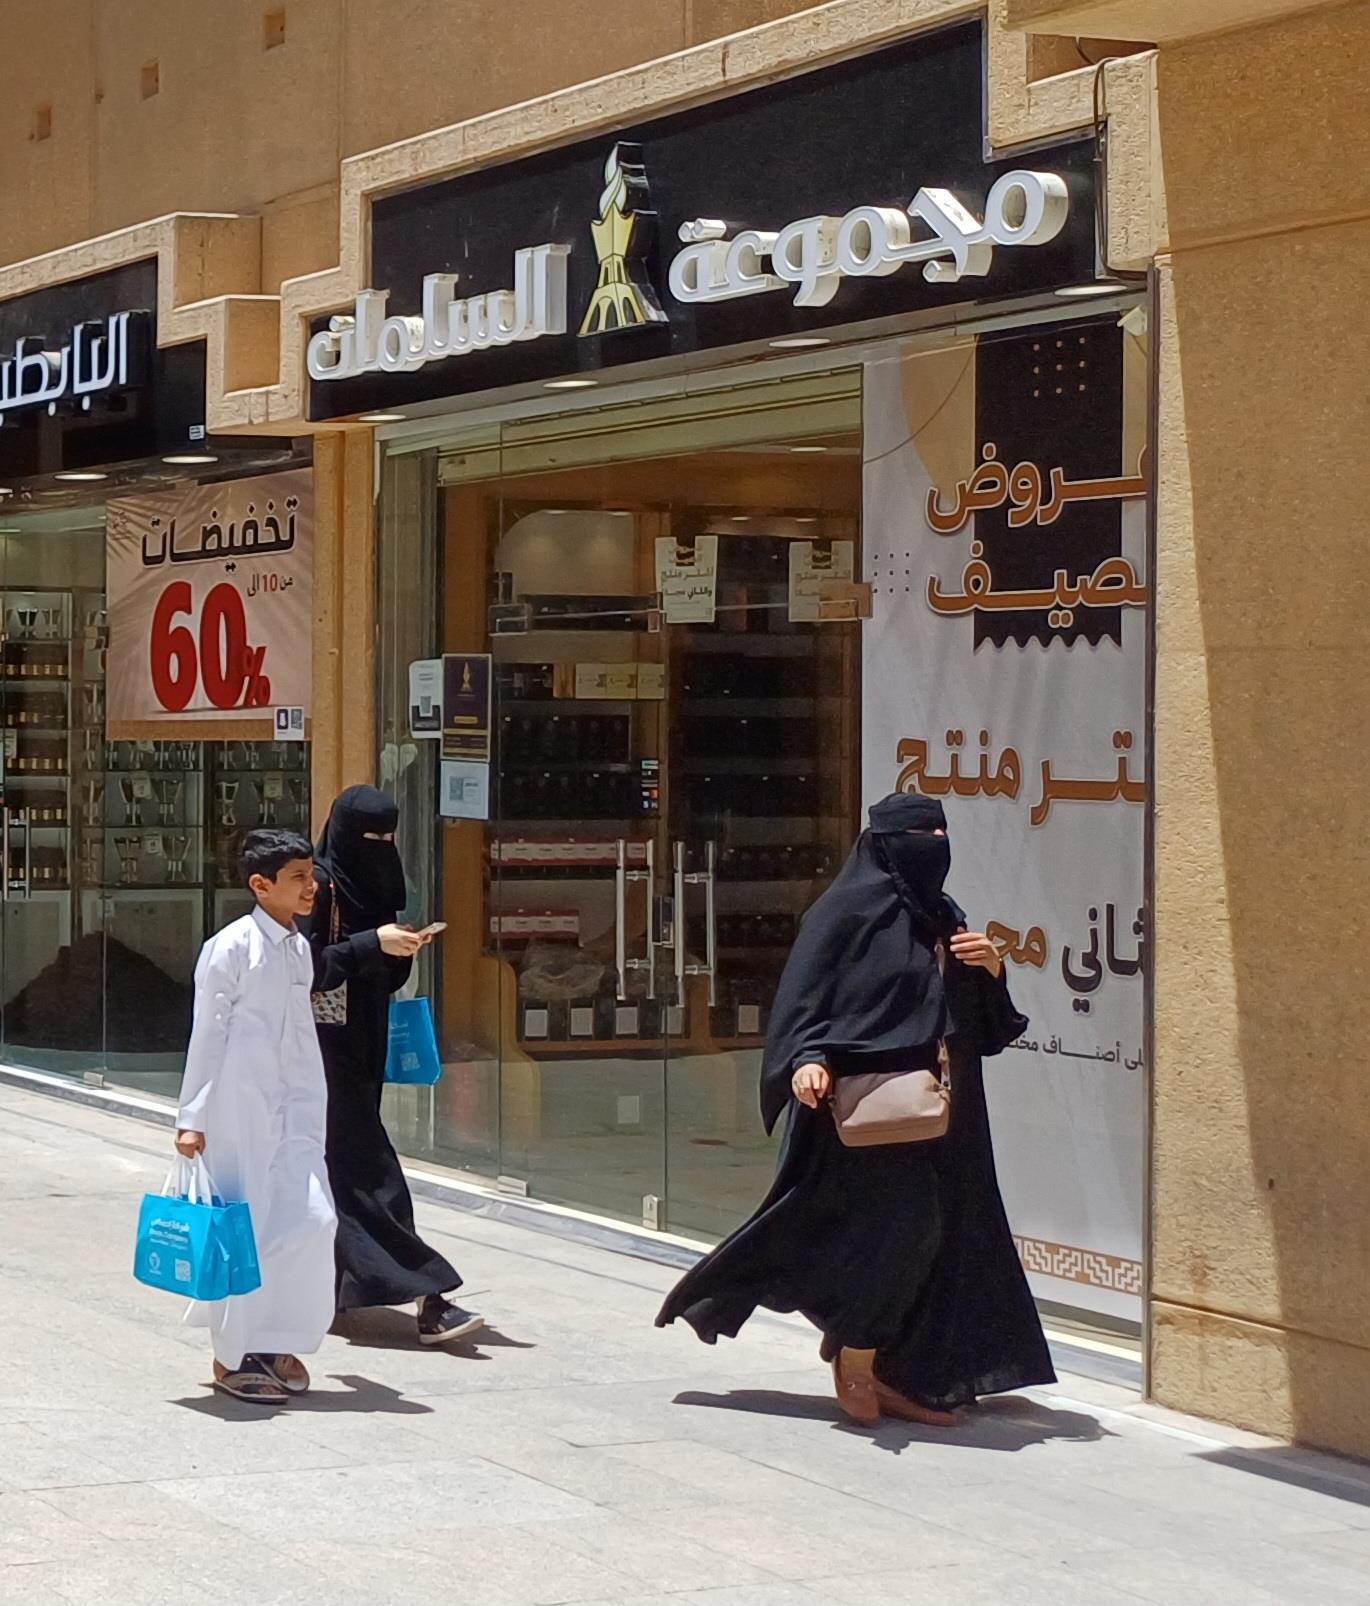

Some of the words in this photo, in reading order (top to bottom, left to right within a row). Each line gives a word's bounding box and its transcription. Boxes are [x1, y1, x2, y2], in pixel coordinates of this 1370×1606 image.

[669, 169, 1068, 306] مجموعة
[142, 498, 298, 572] تخفيضات
[262, 573, 278, 592] 10
[926, 540, 1147, 628] صيف
[151, 581, 271, 713] 60%
[895, 728, 1022, 801] منتج
[1028, 729, 1146, 826] تر
[1042, 1034, 1121, 1063] أصناف
[1124, 1047, 1144, 1070] لى
